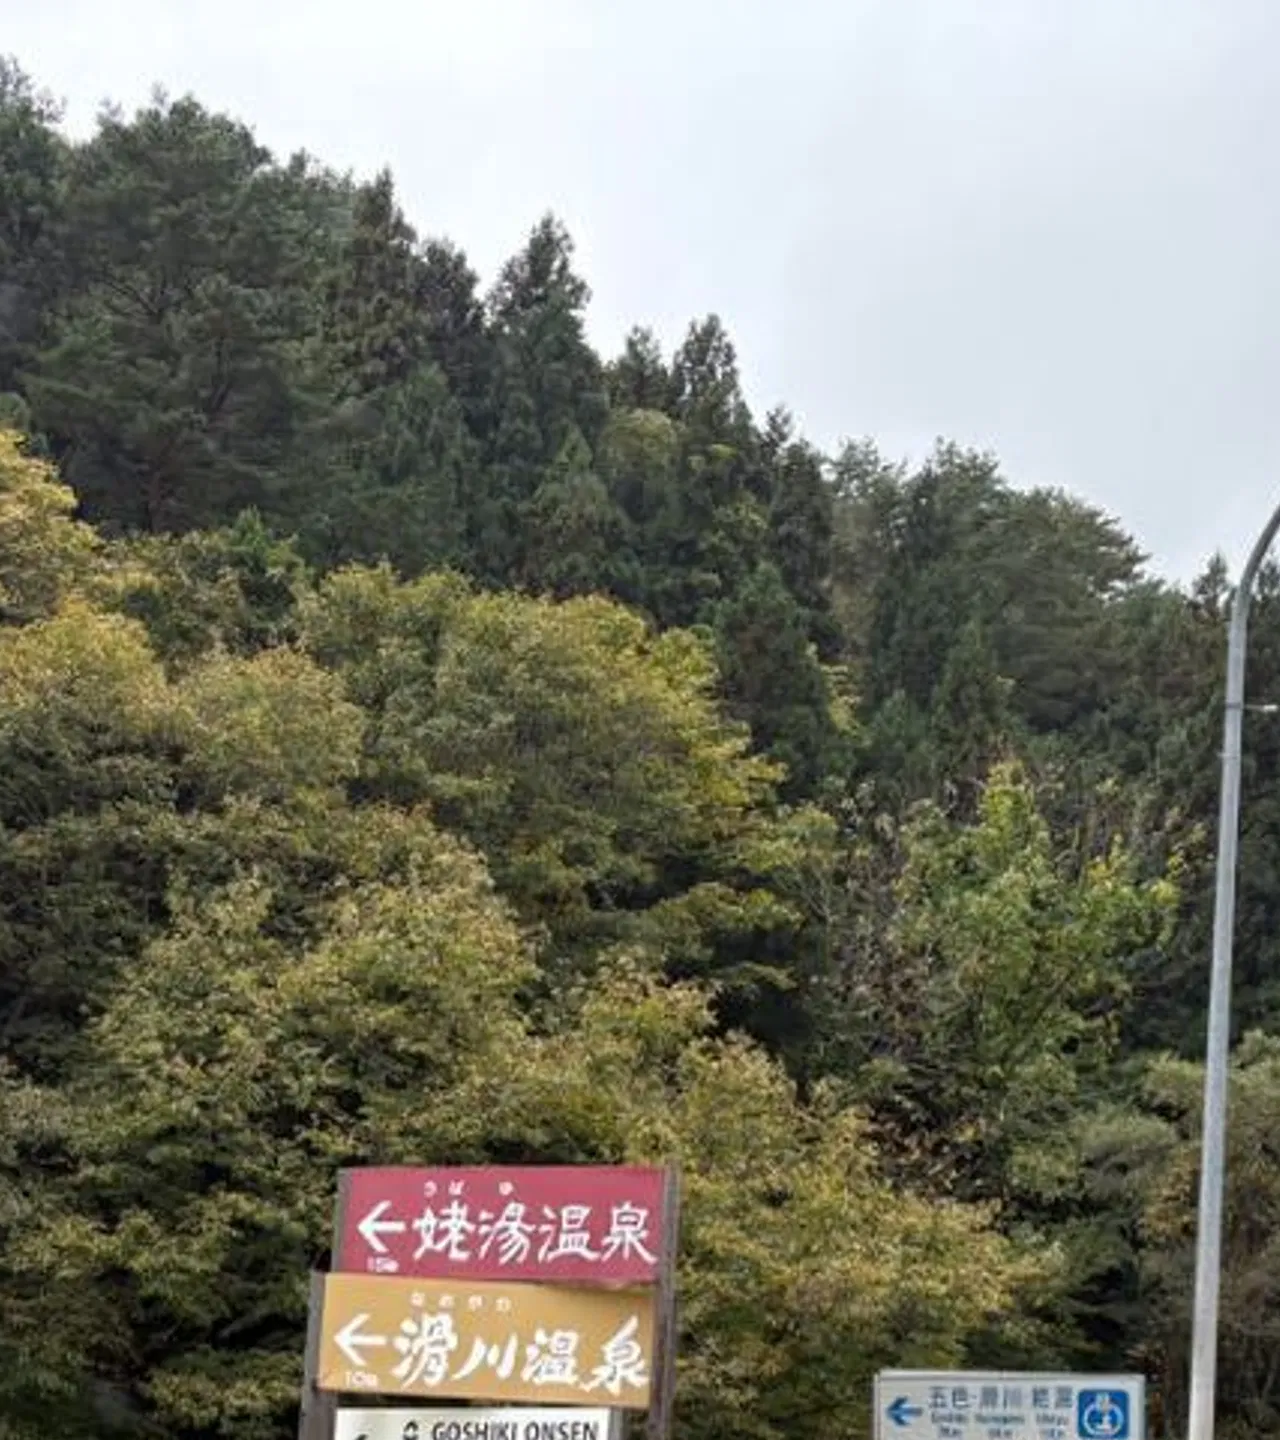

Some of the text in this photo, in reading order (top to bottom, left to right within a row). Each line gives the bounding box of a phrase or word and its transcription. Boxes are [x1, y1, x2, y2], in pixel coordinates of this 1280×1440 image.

[412, 1200, 658, 1265] 姥湯温泉
[390, 1311, 650, 1396] 滑川温泉
